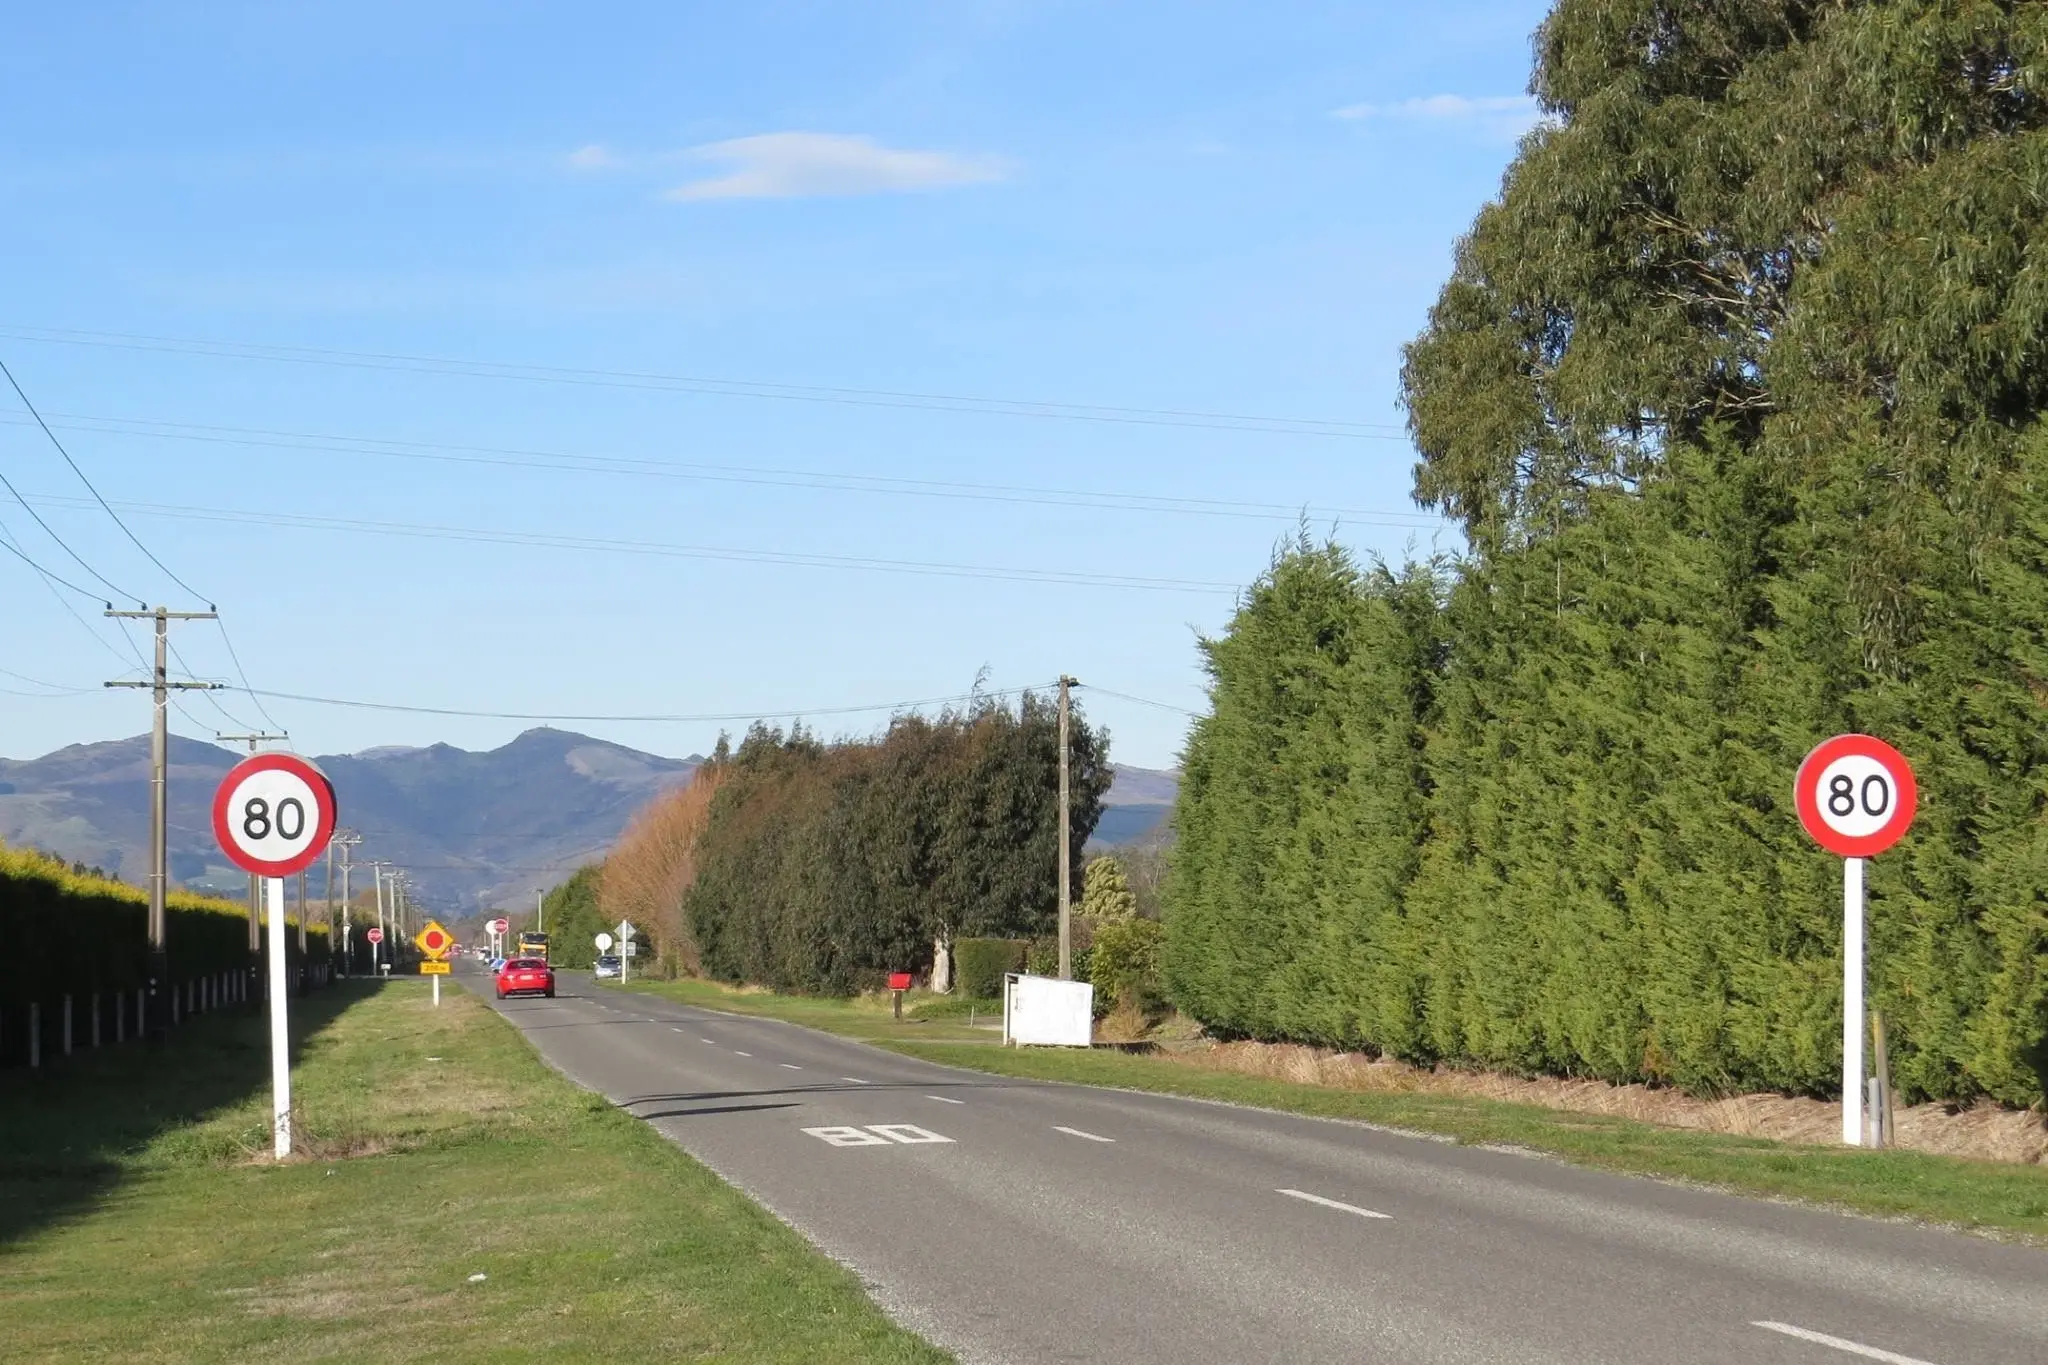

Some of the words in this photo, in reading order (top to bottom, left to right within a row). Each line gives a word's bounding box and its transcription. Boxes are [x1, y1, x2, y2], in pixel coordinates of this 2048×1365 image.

[1828, 774, 1889, 817] 80
[244, 797, 305, 840] 80
[800, 1124, 957, 1147] 80
